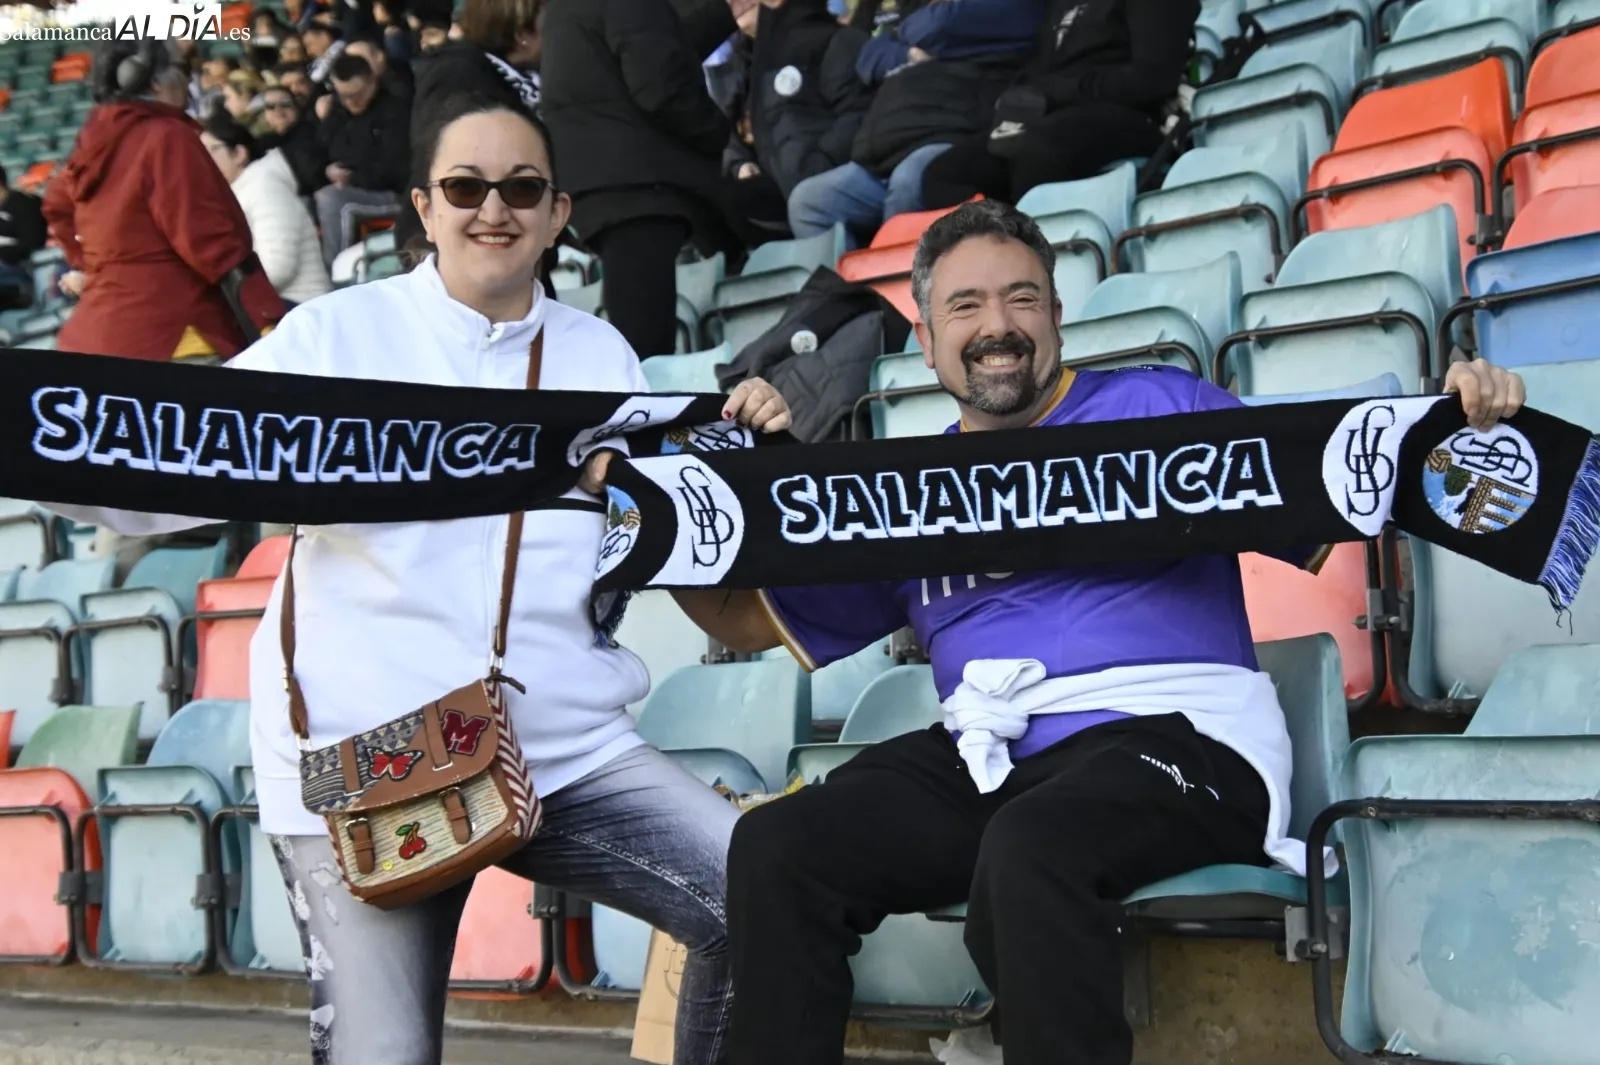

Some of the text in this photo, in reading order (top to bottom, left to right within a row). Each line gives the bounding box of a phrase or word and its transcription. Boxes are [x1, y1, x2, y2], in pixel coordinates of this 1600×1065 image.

[32, 386, 541, 482] SALAMANCA
[771, 437, 1283, 544] SALAMANCA
[441, 708, 490, 757] M
